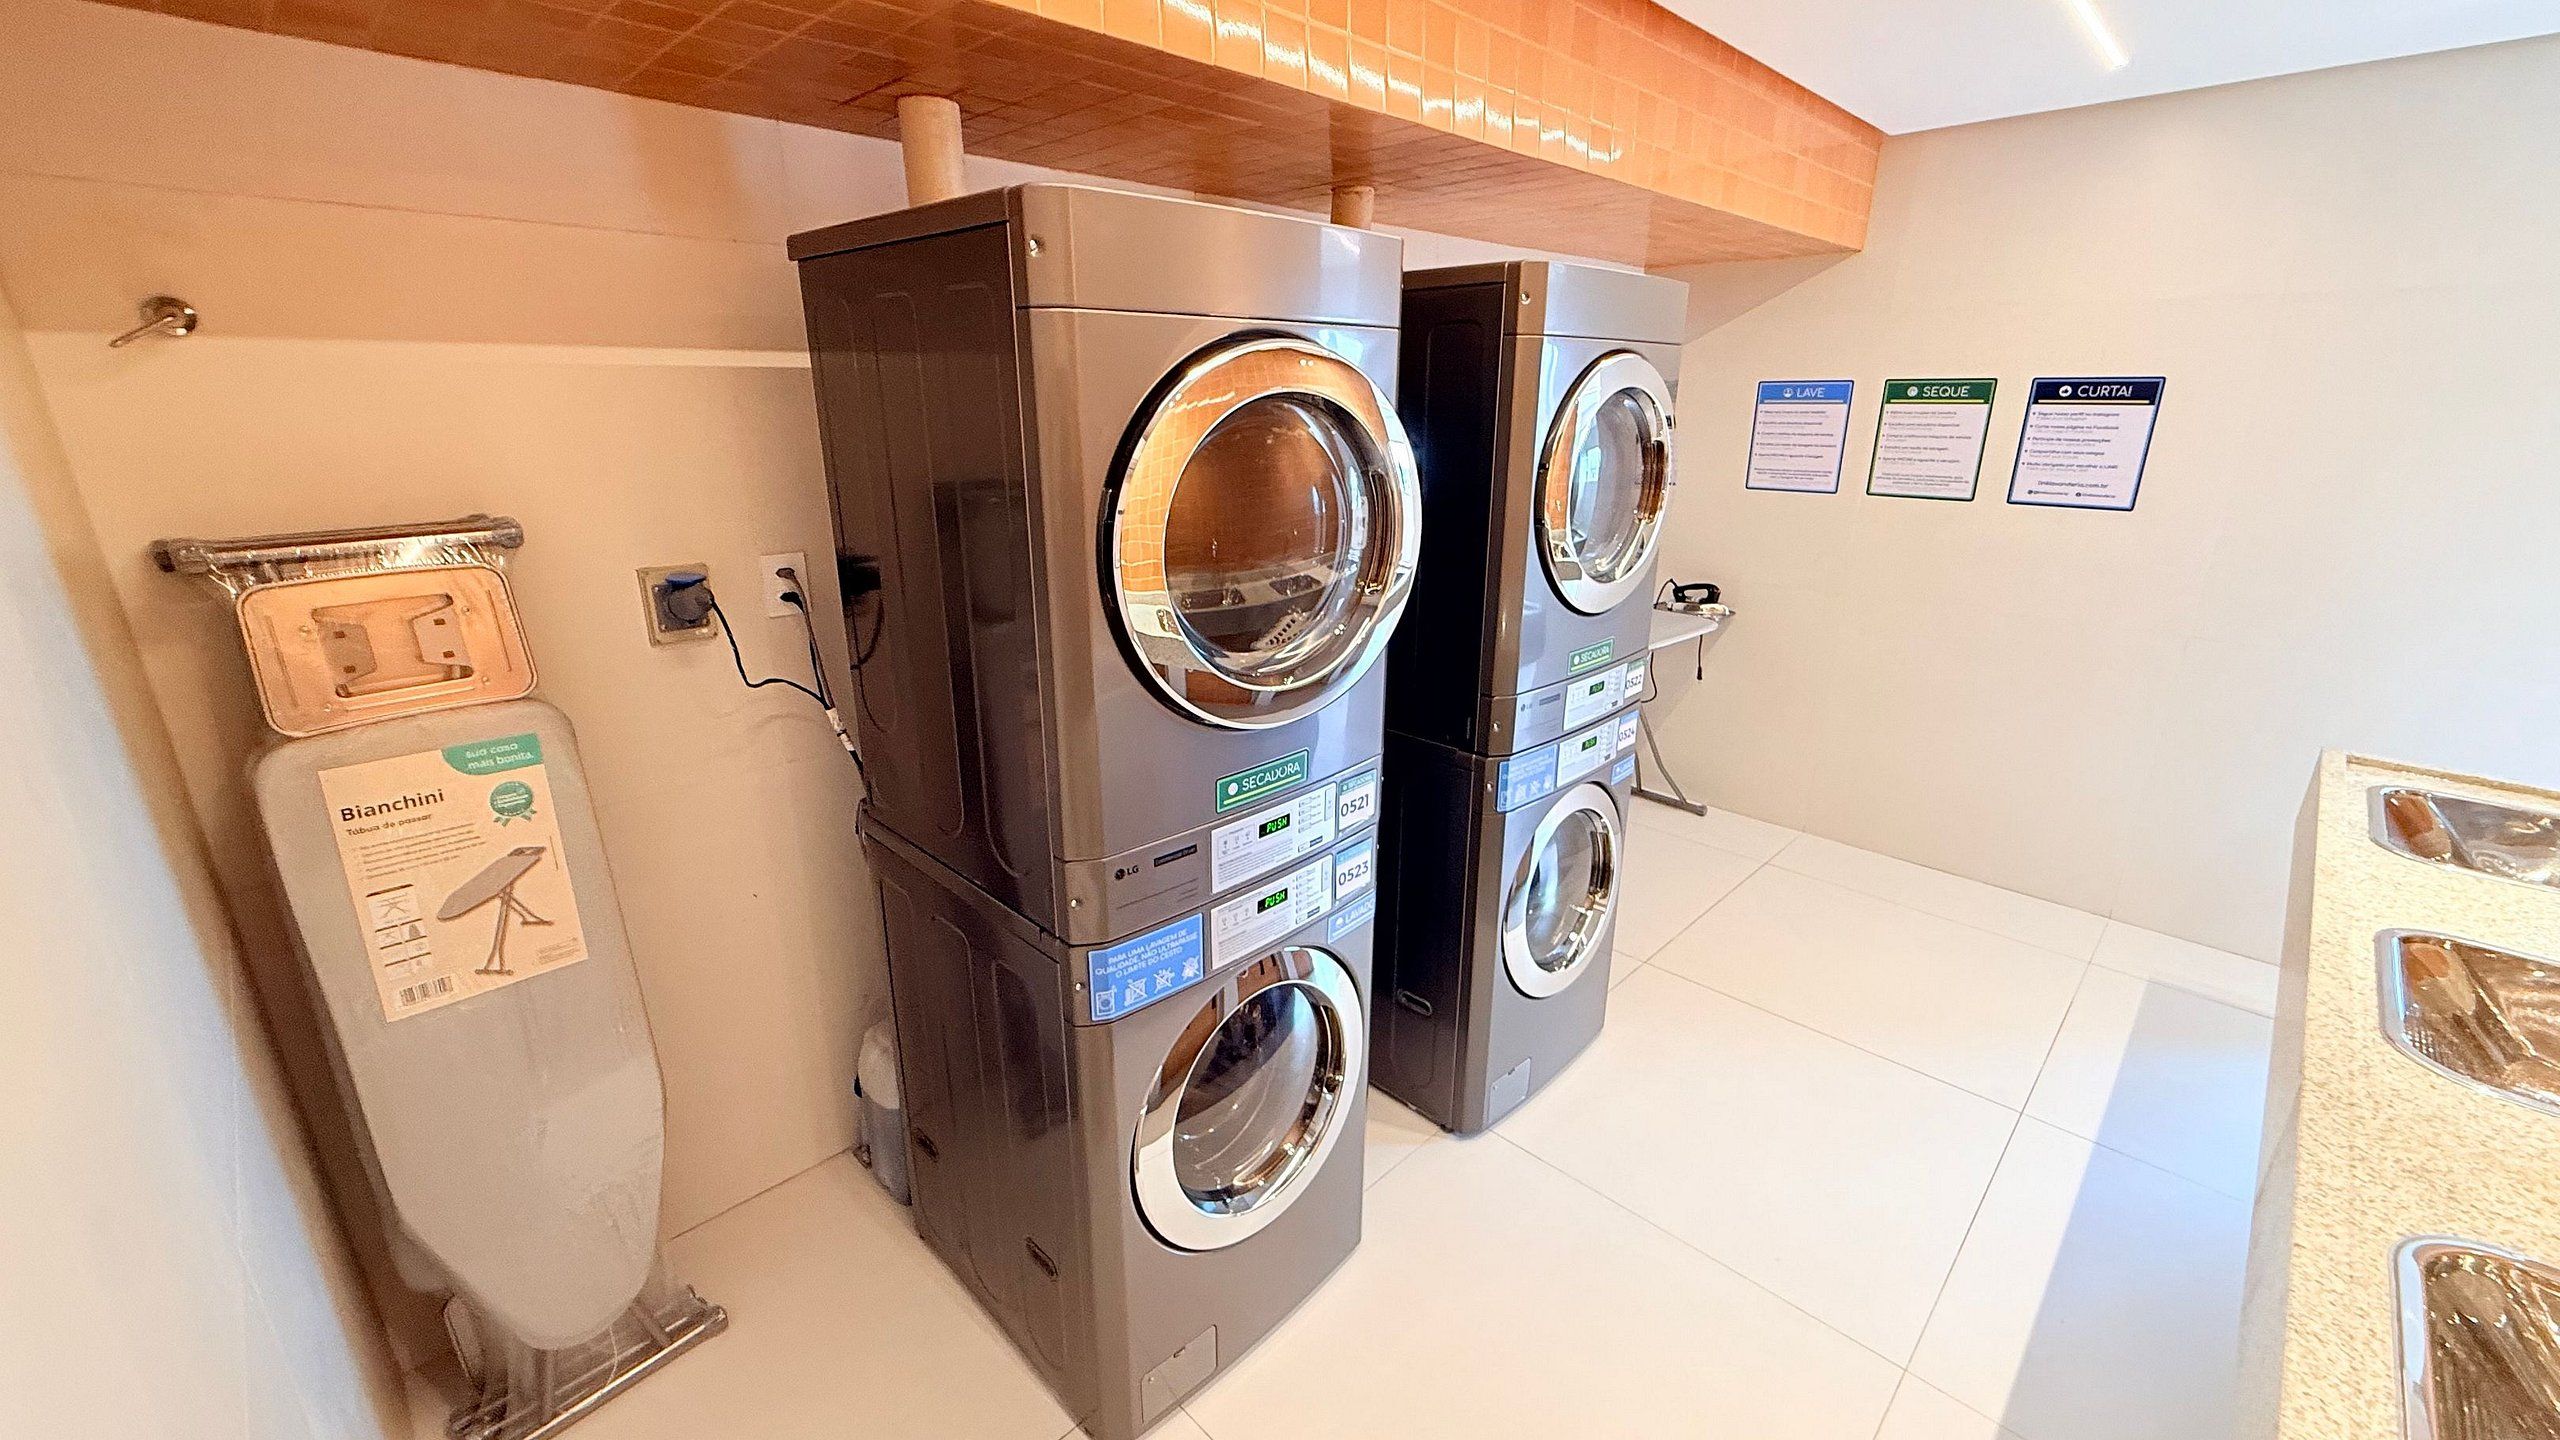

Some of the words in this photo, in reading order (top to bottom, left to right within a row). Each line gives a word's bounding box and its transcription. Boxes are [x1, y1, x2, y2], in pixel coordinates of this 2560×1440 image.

[1796, 387, 1825, 398] LAVE
[1922, 385, 1970, 398] SEQUE
[467, 758, 496, 770] mais
[1242, 761, 1300, 792] SECADORA
[340, 788, 445, 822] Bianchini
[1340, 793, 1369, 817] 0521
[382, 820, 396, 831] de
[397, 813, 433, 827] passar
[1126, 864, 1140, 876] LG
[1338, 860, 1369, 886] 0523
[1108, 952, 1127, 964] PARA
[1127, 946, 1145, 957] UMA
[1145, 933, 1177, 951] LAVAGEM
[1178, 928, 1188, 938] DE
[1141, 948, 1157, 961] NÃO
[1157, 931, 1198, 953] ULTRAPASSE
[1115, 970, 1123, 978] O
[1123, 961, 1147, 976] LIMITE
[1147, 956, 1159, 966] DO
[1160, 946, 1183, 960] CESTO
